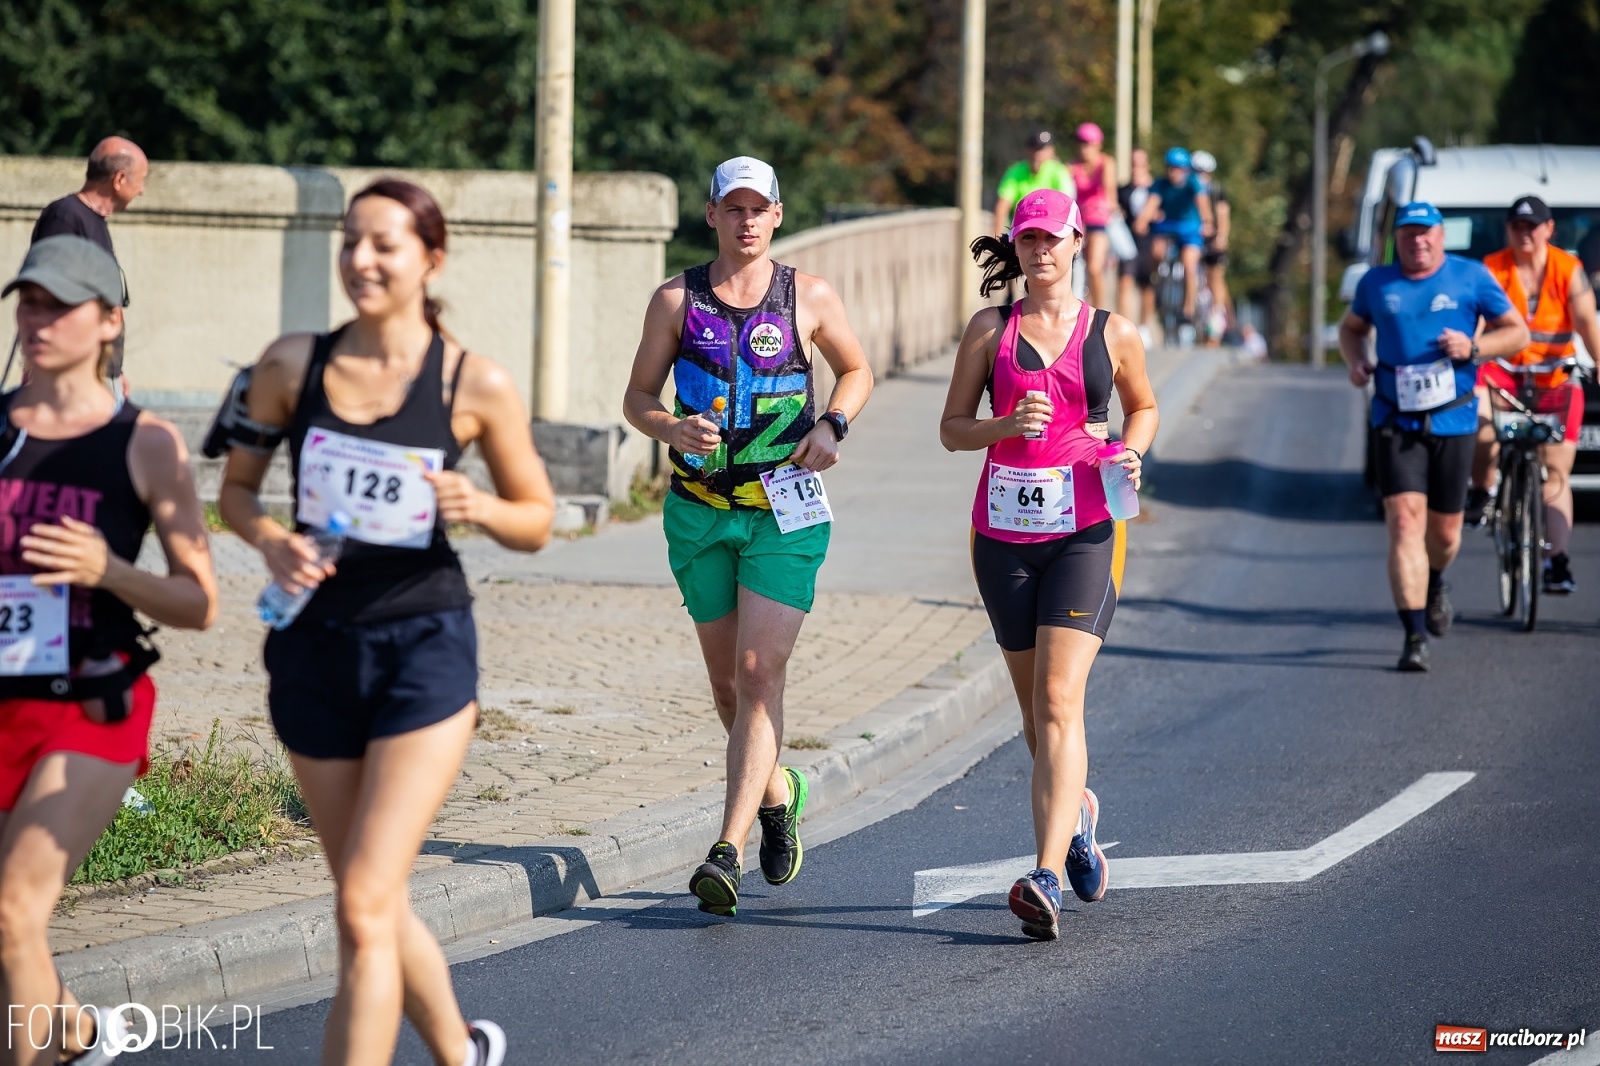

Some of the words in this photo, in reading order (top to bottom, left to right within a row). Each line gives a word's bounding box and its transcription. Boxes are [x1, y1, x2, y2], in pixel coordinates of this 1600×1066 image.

[693, 301, 718, 315] deep
[751, 335, 782, 346] ANTON
[345, 466, 402, 504] 128
[794, 477, 822, 500] 150
[1017, 486, 1046, 508] 64
